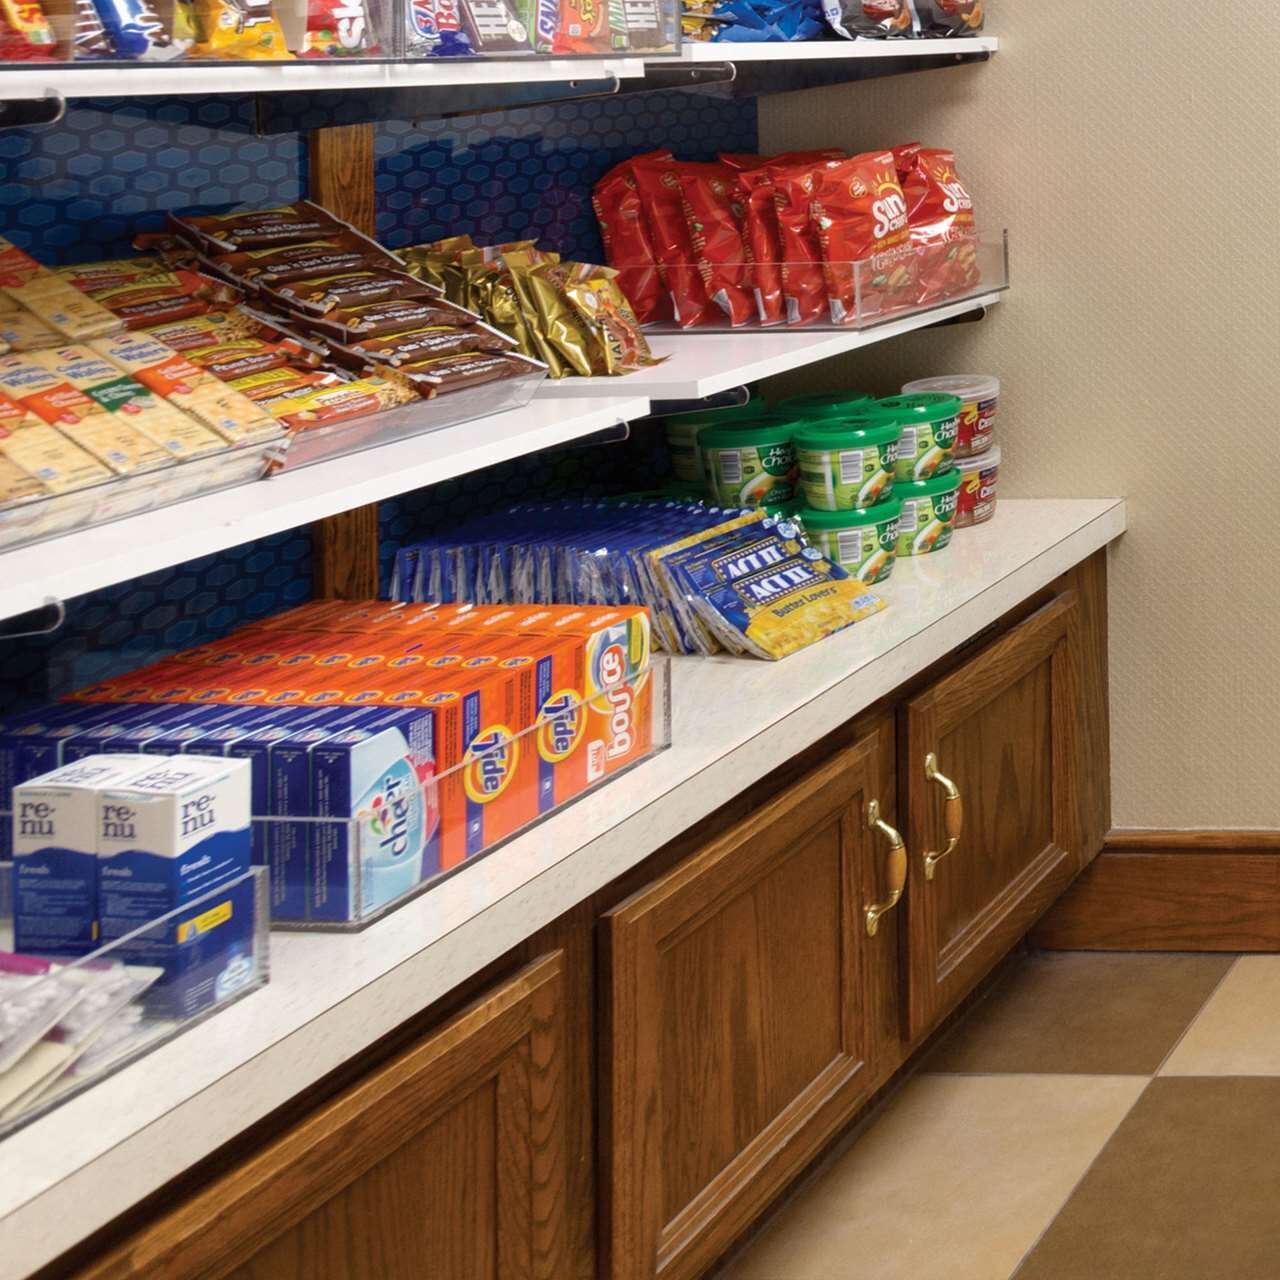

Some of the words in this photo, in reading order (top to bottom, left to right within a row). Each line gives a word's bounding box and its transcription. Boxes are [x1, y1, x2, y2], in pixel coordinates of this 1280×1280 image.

[872, 193, 908, 240] Sun
[726, 551, 764, 580] ACT
[750, 573, 788, 600] ACT
[787, 565, 811, 587] II
[771, 597, 805, 618] Butter
[804, 586, 839, 605] Lovers
[601, 645, 634, 760] bounce
[544, 695, 578, 754] Tide
[471, 732, 506, 794] Tide
[19, 819, 55, 836] nu
[102, 822, 137, 839] nu
[182, 809, 216, 837] nu
[379, 776, 411, 856] cheer
